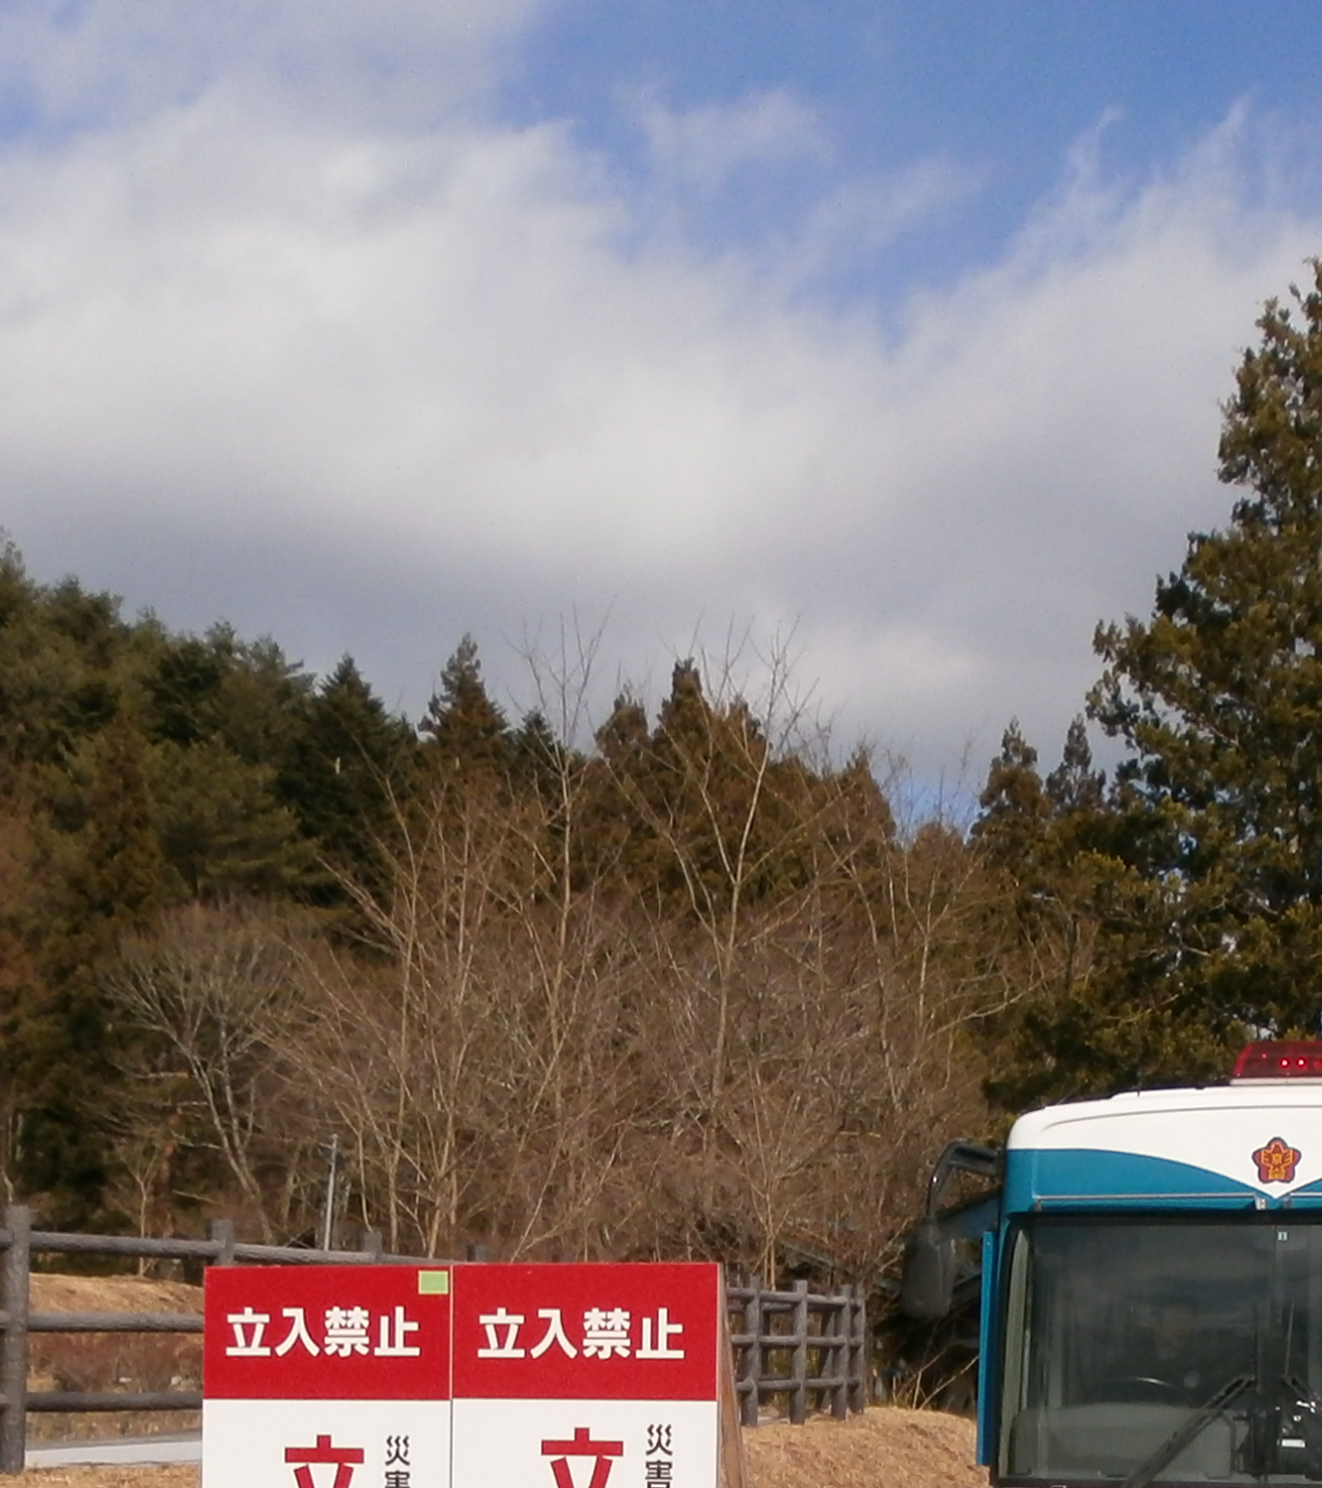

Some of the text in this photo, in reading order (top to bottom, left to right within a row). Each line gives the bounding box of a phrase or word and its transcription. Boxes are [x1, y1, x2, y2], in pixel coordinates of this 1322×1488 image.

[225, 1305, 421, 1358] 立入禁止
[476, 1307, 685, 1360] 立入禁止
